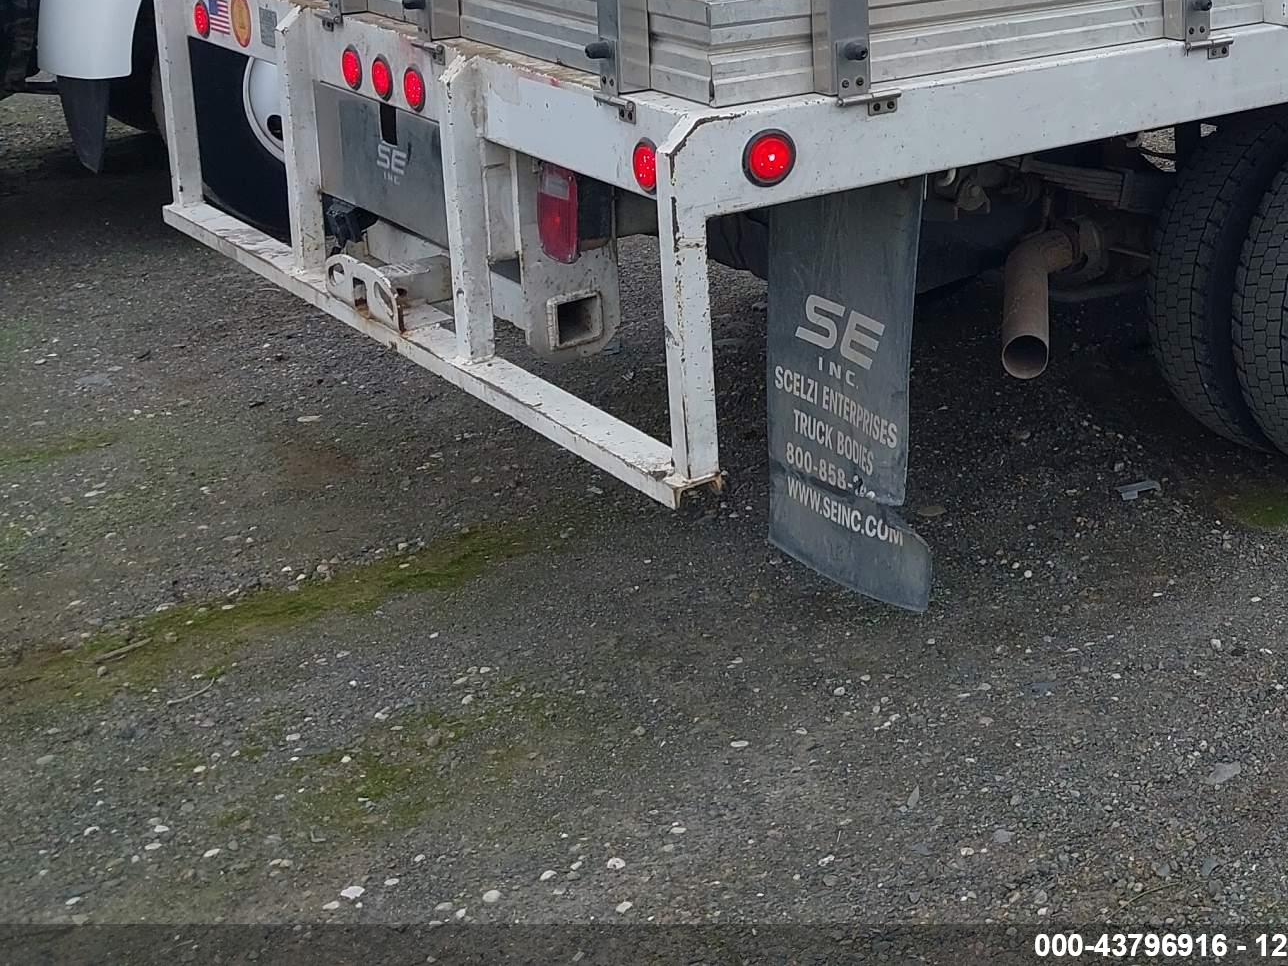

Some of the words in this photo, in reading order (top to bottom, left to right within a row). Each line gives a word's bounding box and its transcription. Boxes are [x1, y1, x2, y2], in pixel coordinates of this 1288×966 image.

[376, 144, 407, 176] SE
[794, 294, 886, 371] SE
[774, 365, 818, 406] SCELZI
[822, 385, 898, 449] ENTERPRISES
[818, 356, 859, 390] INC.
[793, 409, 833, 450] TRUCK
[837, 430, 874, 476] BODIES
[787, 475, 904, 547] WWW.SEINC.COM
